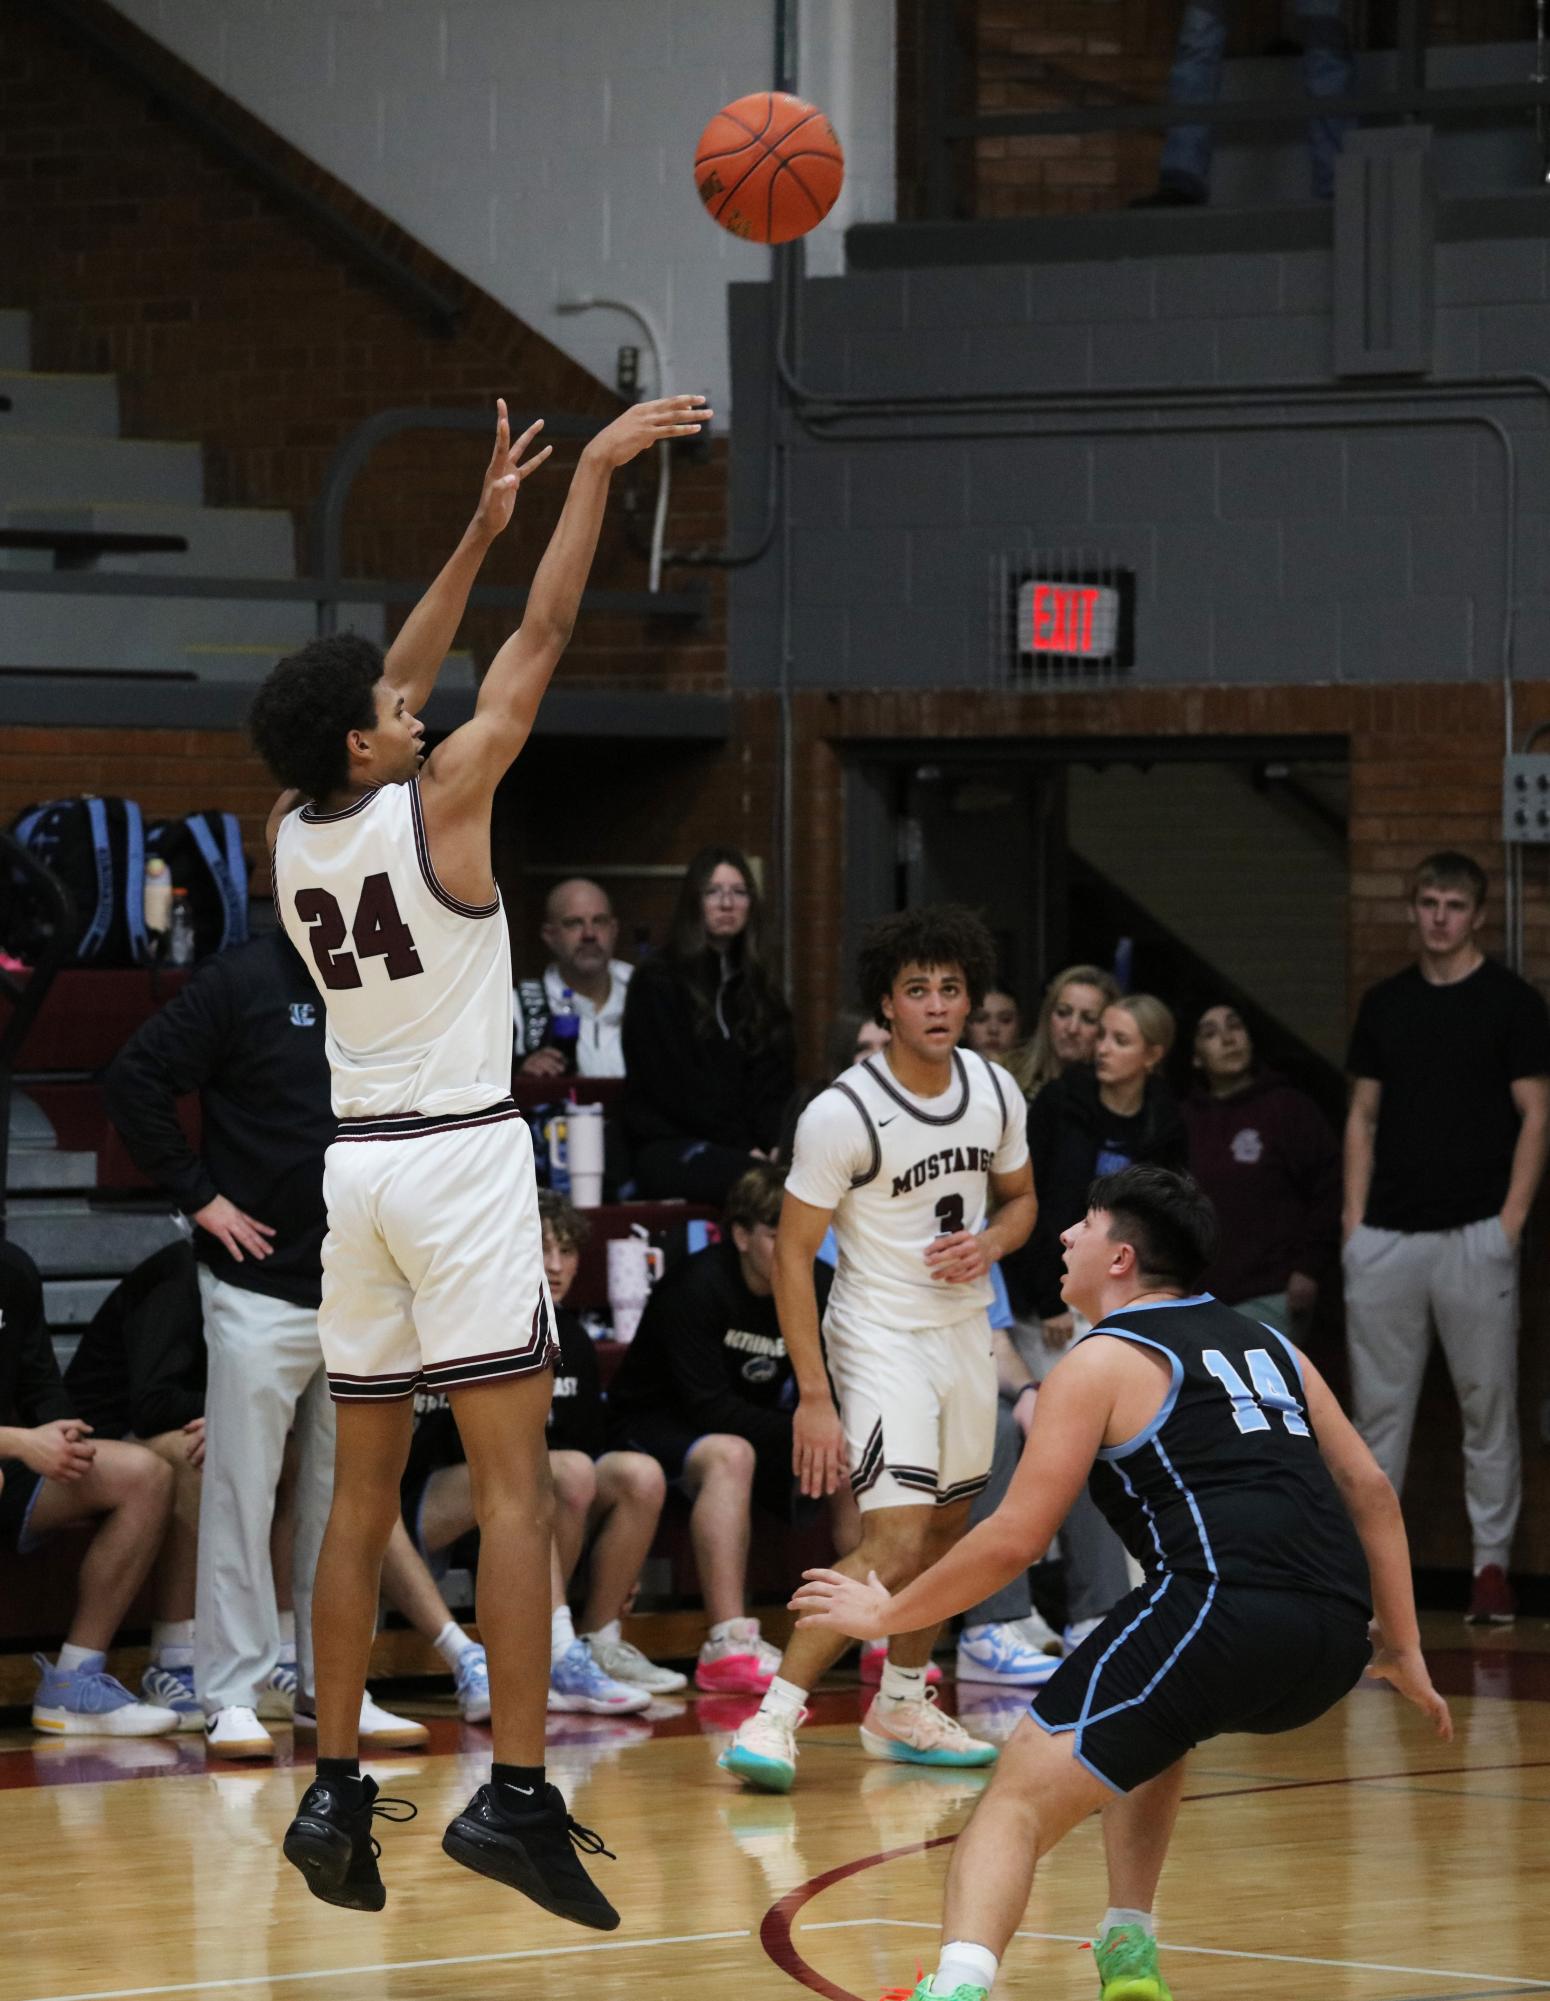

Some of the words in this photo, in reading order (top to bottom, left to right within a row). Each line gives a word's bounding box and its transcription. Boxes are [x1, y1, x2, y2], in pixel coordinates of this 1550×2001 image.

[1032, 584, 1100, 653] EXIT
[294, 872, 425, 990] 24
[1202, 1348, 1311, 1437] 14
